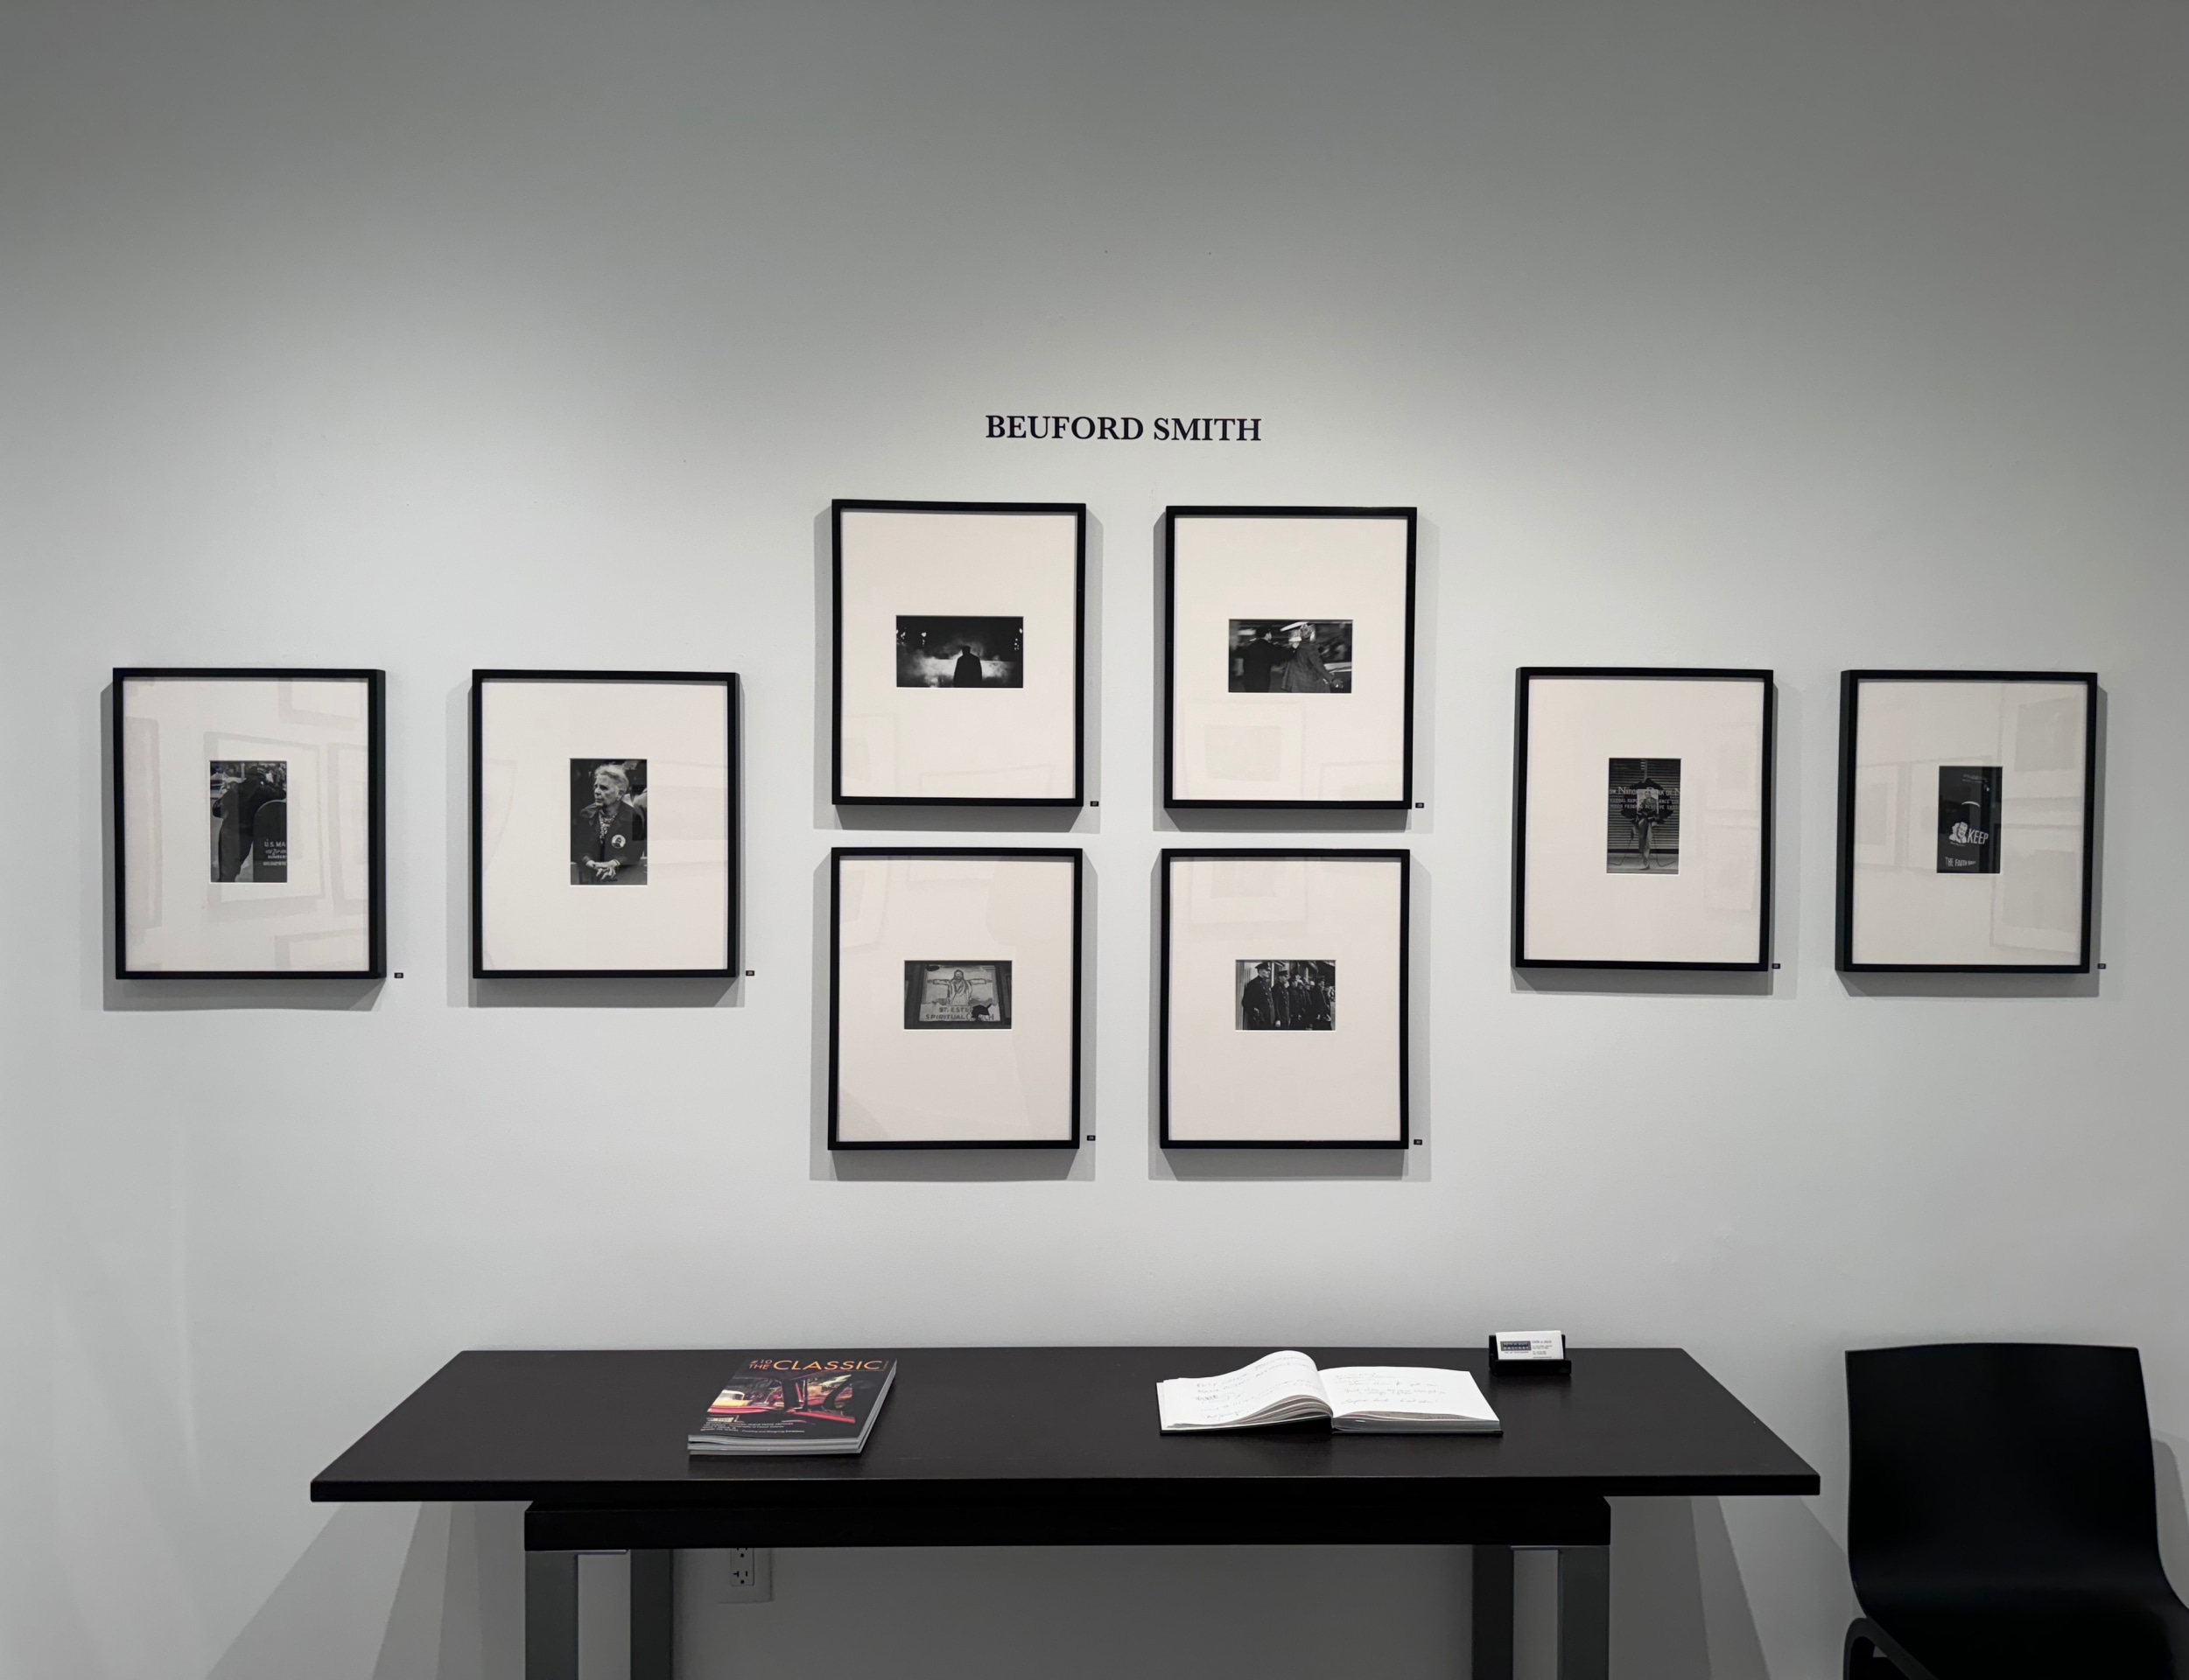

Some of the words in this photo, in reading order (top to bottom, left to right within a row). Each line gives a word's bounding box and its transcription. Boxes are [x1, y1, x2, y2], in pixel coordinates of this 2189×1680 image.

[986, 415, 1144, 440] BEUFORD
[1154, 417, 1262, 441] SMITH
[1968, 829, 1989, 844] KEEP
[1945, 857, 1954, 867] THE
[773, 1359, 883, 1371] CLASSIC
